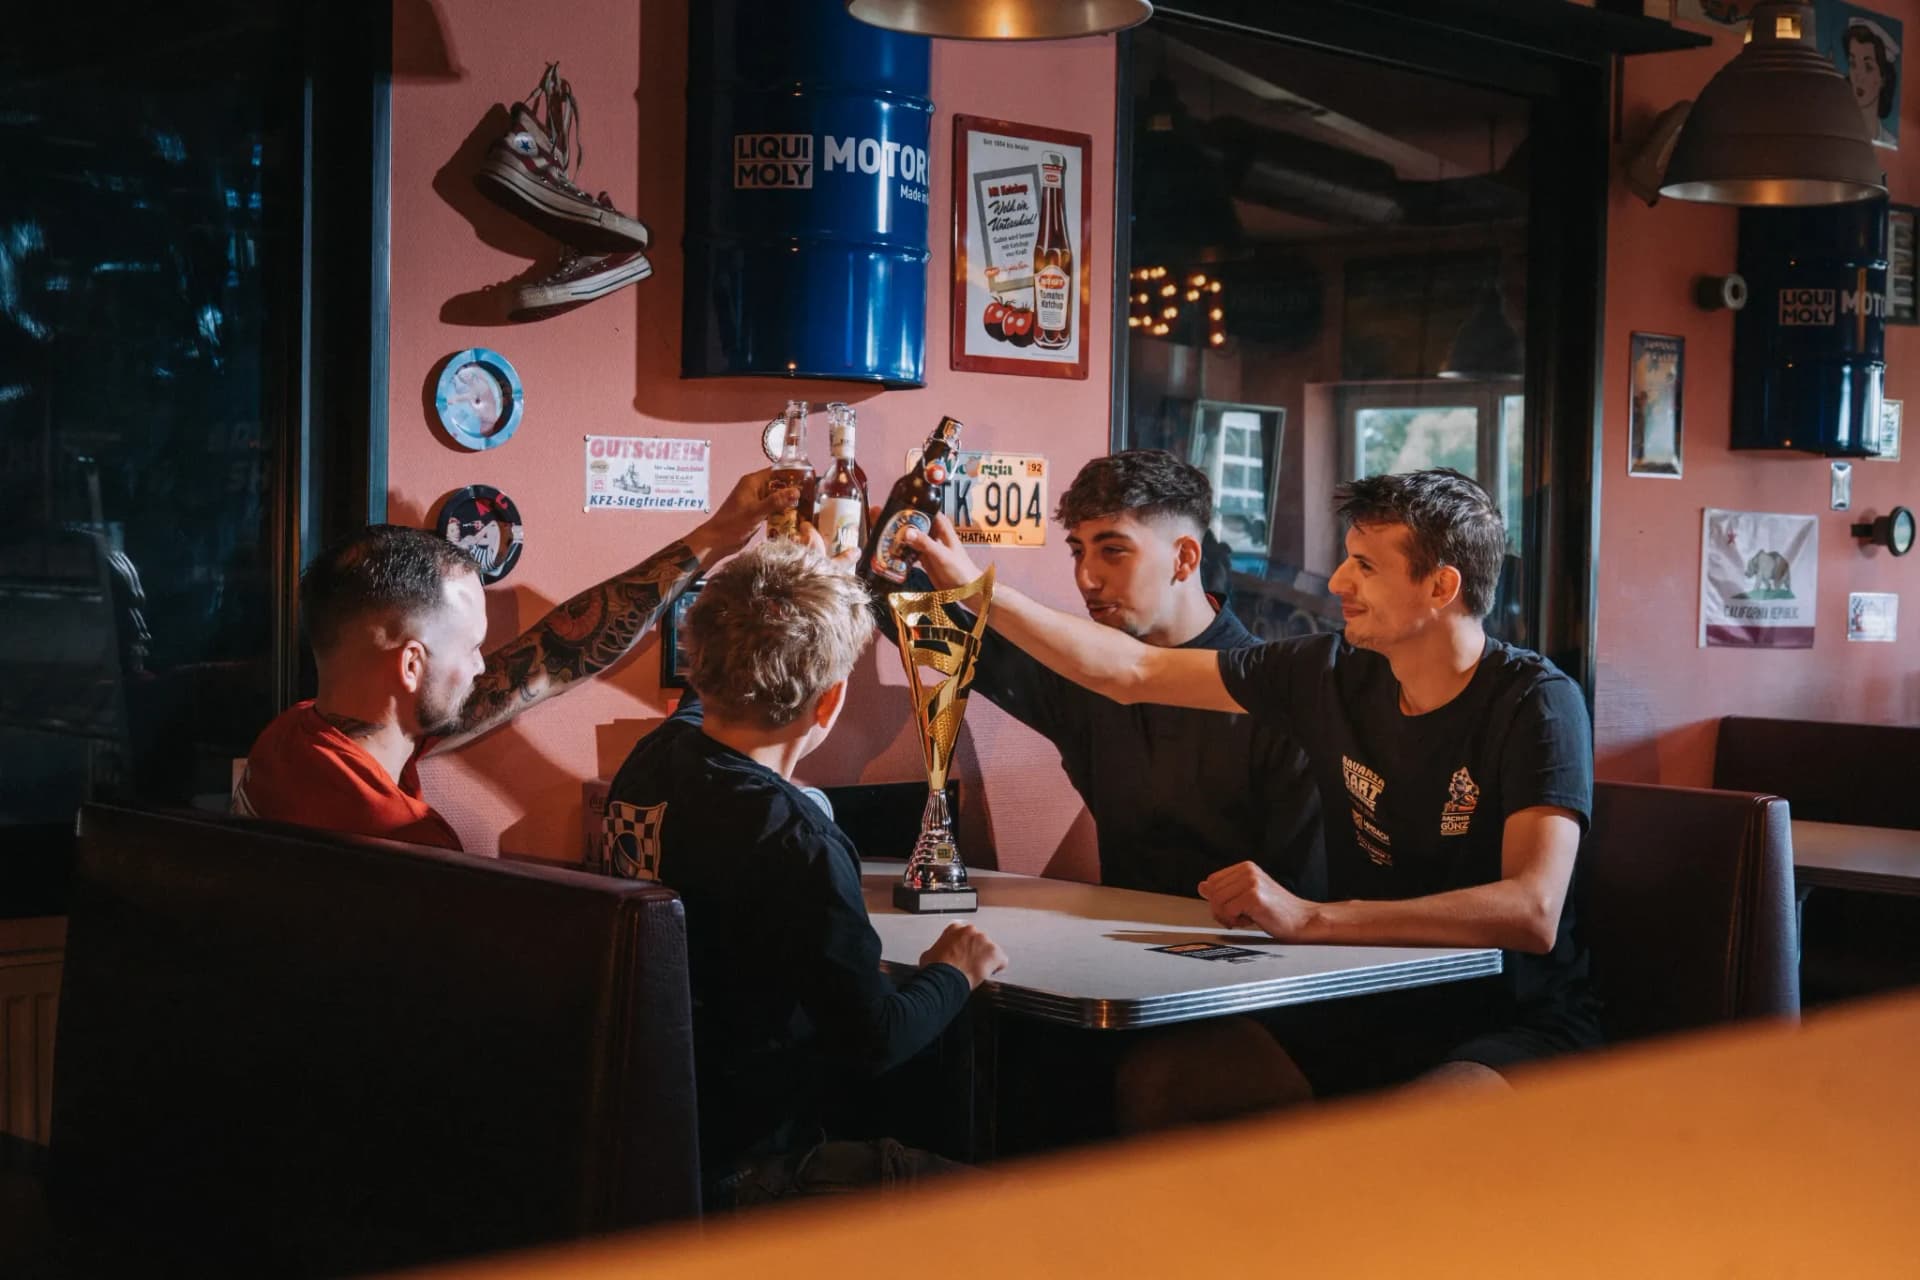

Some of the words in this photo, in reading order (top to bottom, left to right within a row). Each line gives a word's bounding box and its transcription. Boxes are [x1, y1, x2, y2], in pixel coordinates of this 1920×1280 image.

[738, 136, 809, 160] LIQUI
[824, 135, 930, 187] MOTOR
[738, 163, 811, 186] MOLY
[900, 183, 921, 202] Made
[1783, 290, 1832, 305] LIQUI
[1783, 309, 1832, 323] MOLY
[589, 438, 705, 461] GUTSCHEIN
[589, 494, 705, 509] KFZ-Siegfried-Frey
[984, 481, 1042, 528] 904
